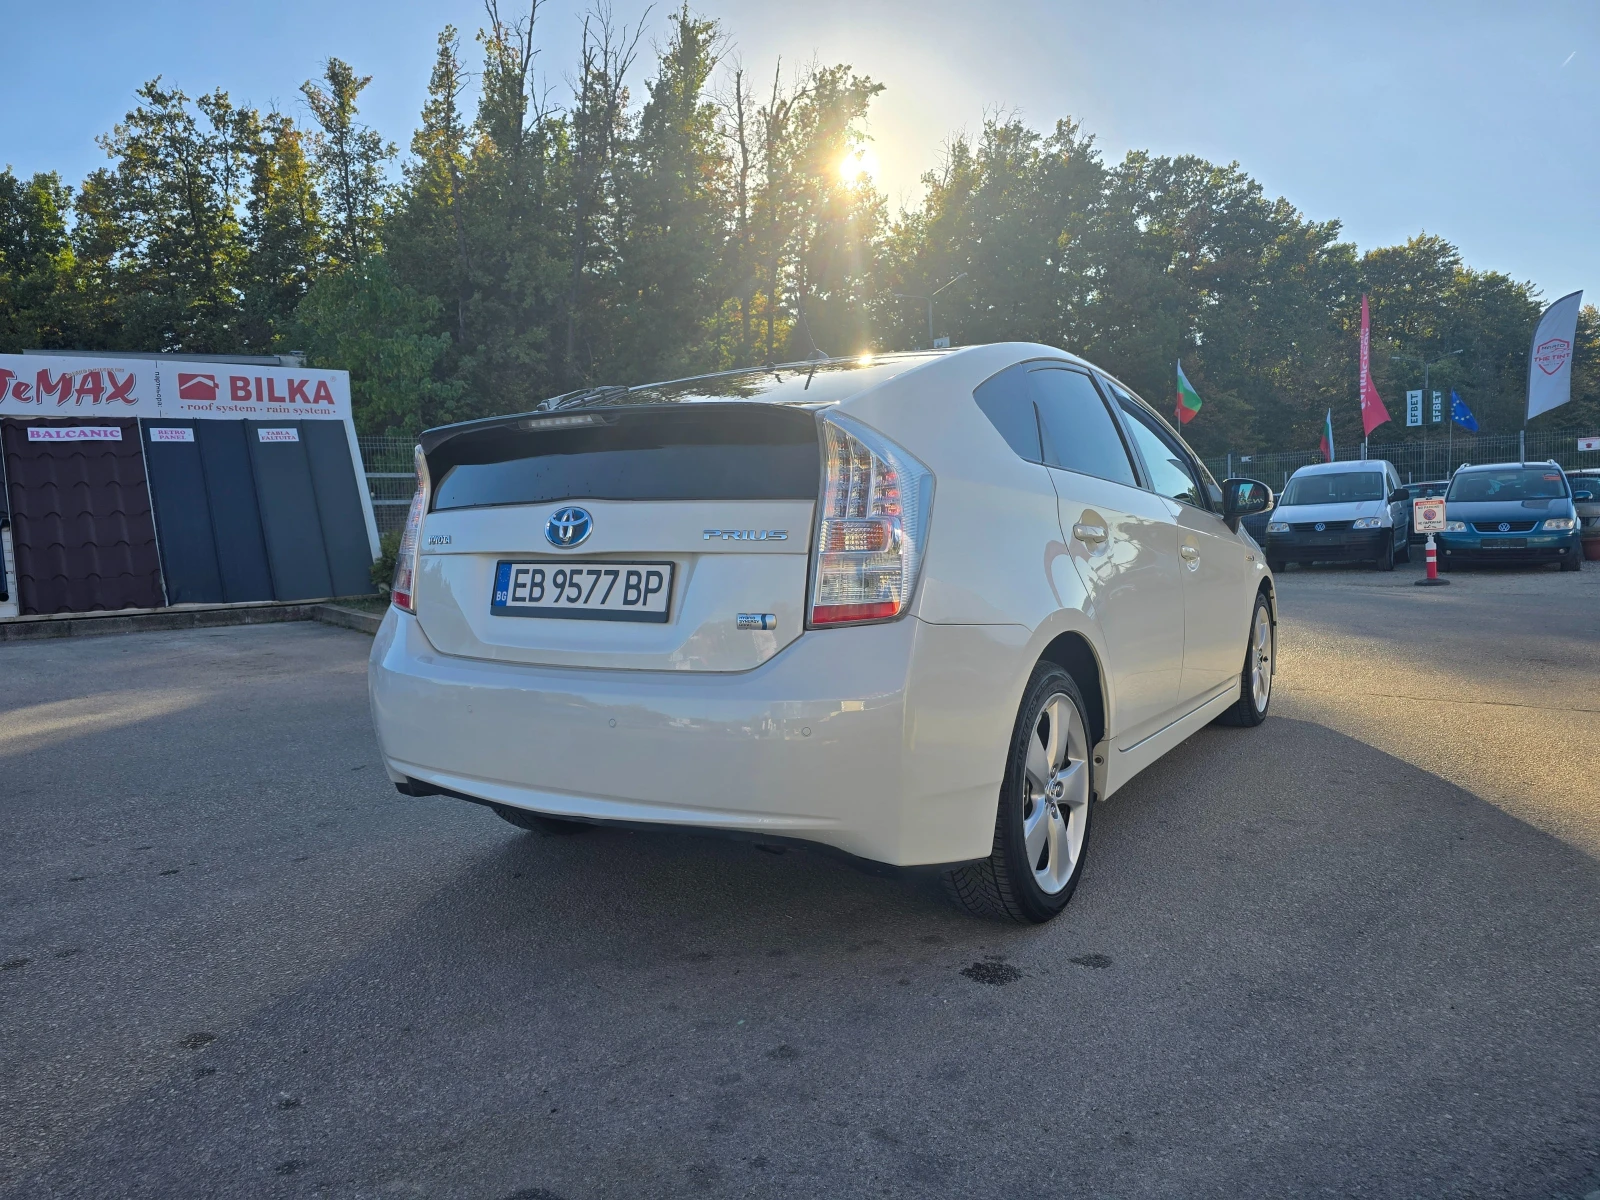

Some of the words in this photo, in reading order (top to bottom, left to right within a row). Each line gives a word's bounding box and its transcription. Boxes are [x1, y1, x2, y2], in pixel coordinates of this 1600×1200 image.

[229, 376, 335, 405] BILKA
[187, 403, 214, 411] roof
[216, 405, 256, 415] system
[292, 407, 331, 416] system
[1410, 394, 1418, 424] EFBET
[1433, 391, 1441, 422] EFBET
[29, 429, 120, 439] BALCANIC
[703, 529, 788, 541] PRIUS
[496, 591, 507, 601] BG
[511, 568, 546, 603] EB
[552, 569, 620, 605] 9577
[622, 570, 663, 606] BP
